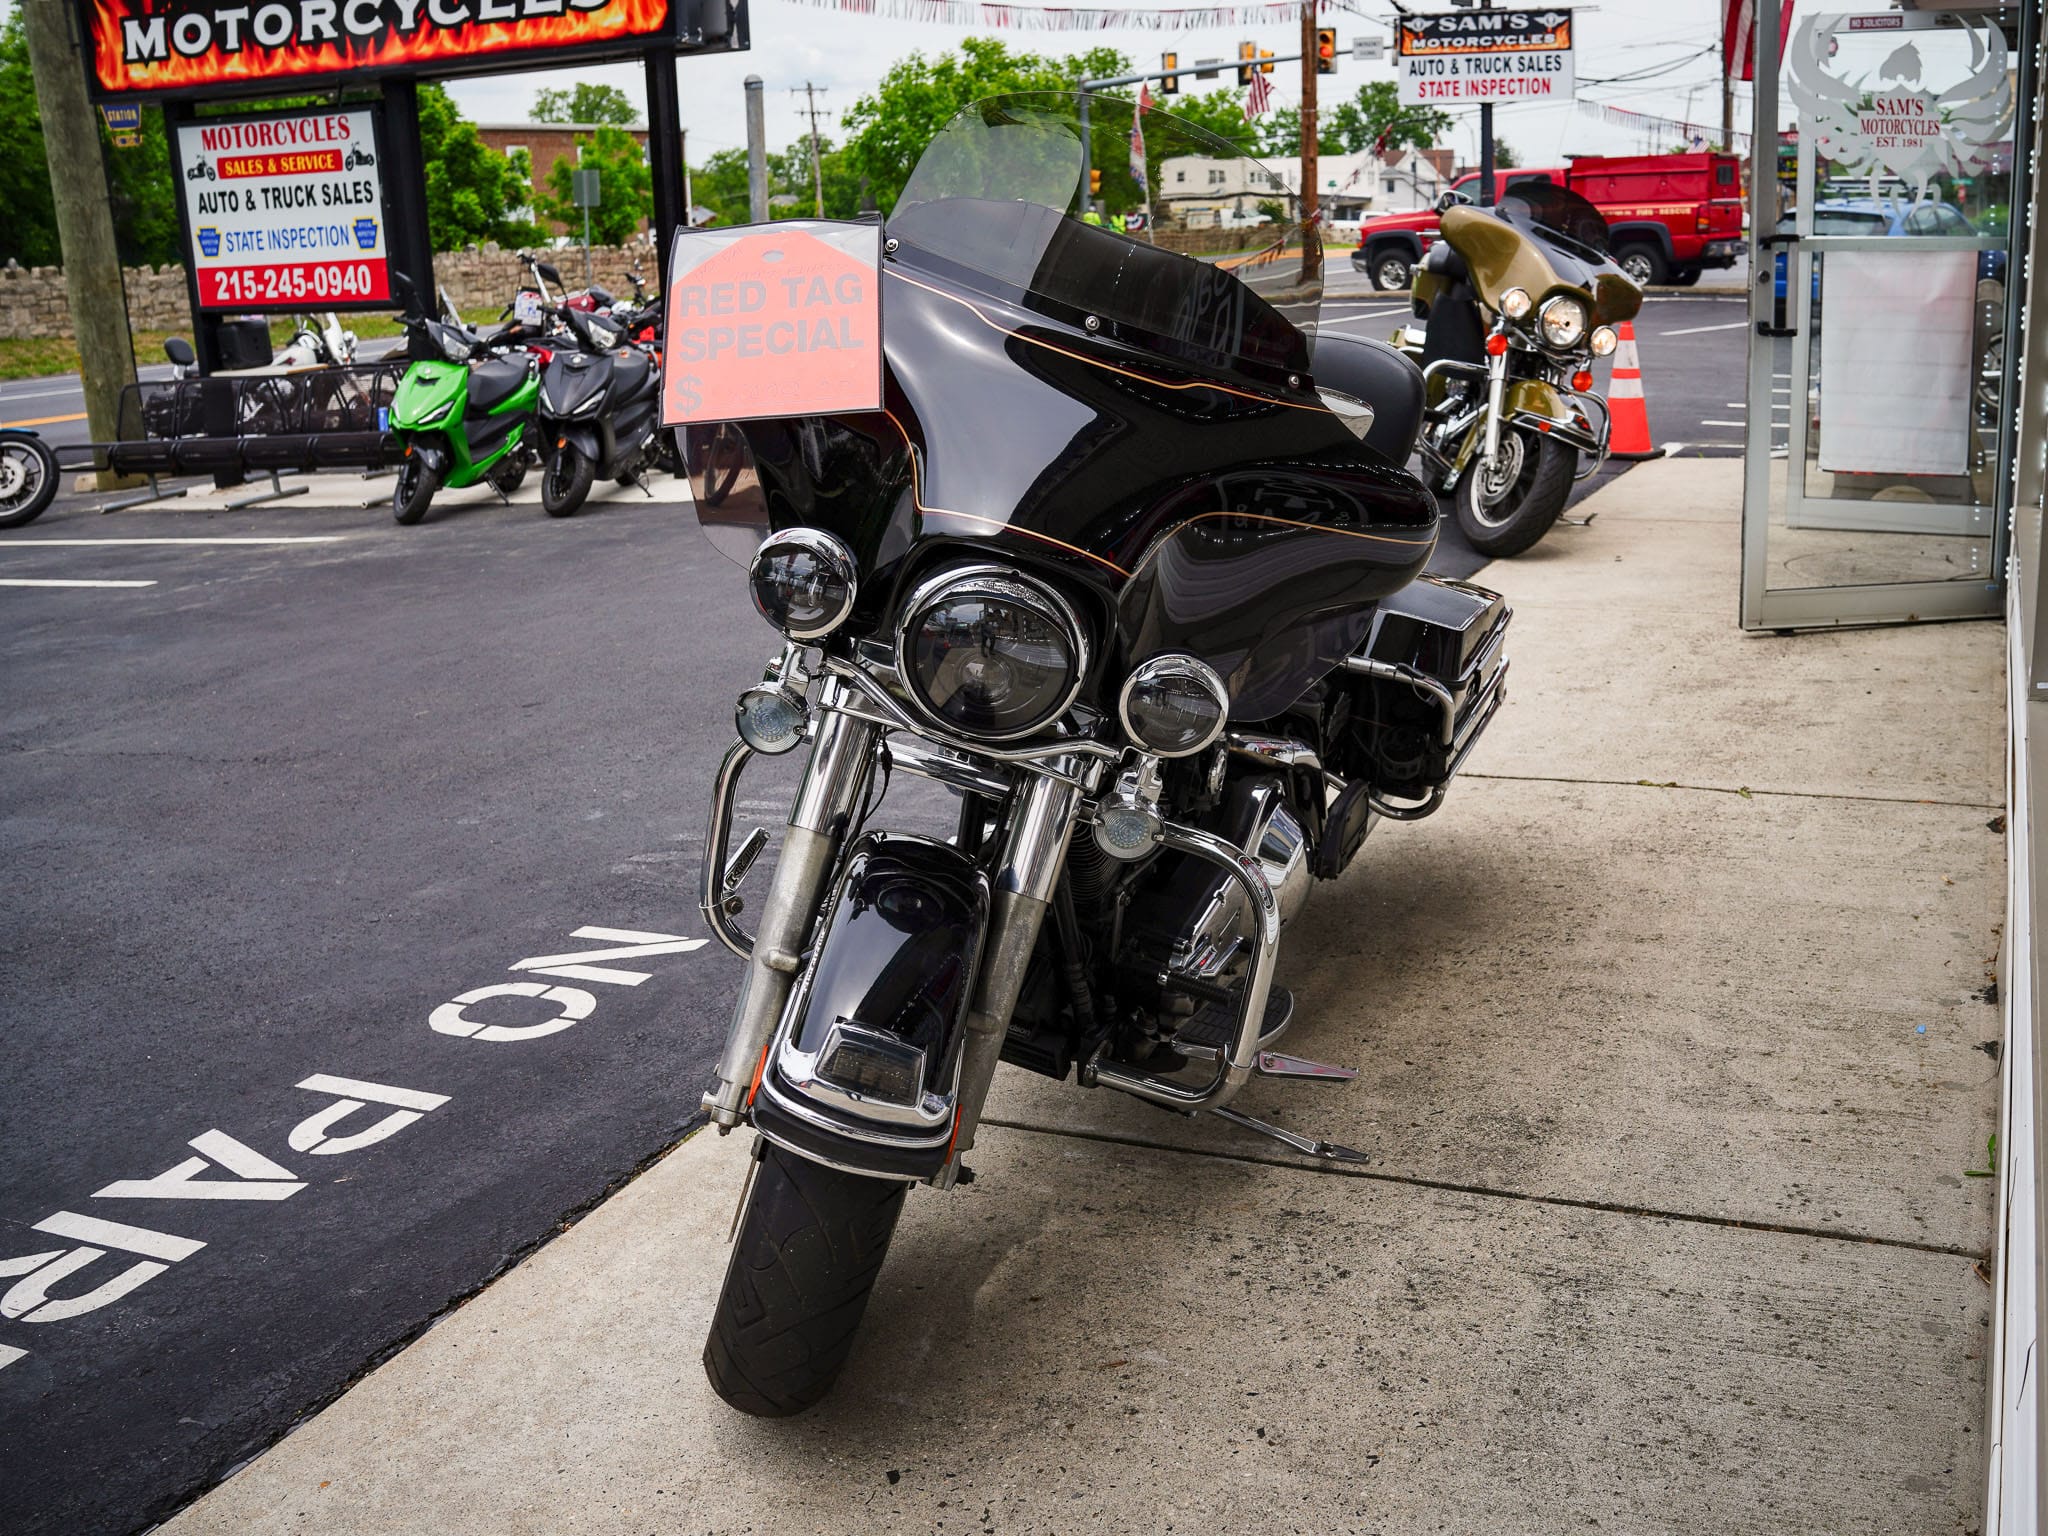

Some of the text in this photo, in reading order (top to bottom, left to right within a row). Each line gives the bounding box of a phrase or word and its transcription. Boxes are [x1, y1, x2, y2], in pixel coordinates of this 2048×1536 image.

[124, 0, 606, 60] MOTORCYC
[1438, 13, 1529, 32] SAM'S
[1412, 33, 1556, 49] MOTORCYCLES
[1409, 54, 1562, 77] AUTO & TRUCK SALES
[1418, 78, 1551, 98] STATE INSPECTION
[108, 109, 137, 121] STATION
[1876, 98, 1924, 116] SAM'S
[201, 115, 350, 151] MOTORCYCLES
[1860, 118, 1940, 136] MOTORCYCLES
[1902, 138, 1923, 147] 1981
[225, 154, 335, 176] SALES & SERVICE
[199, 180, 374, 215] AUTO & TRUCK SALES
[226, 230, 264, 253] STATE
[268, 225, 350, 250] INSPECTION
[215, 264, 372, 300] 215-245-0940
[679, 272, 863, 317] RED TAG
[679, 317, 865, 363] SPECIAL
[674, 374, 704, 417] $
[428, 926, 709, 1042] NO
[0, 1073, 452, 1370] PAR
